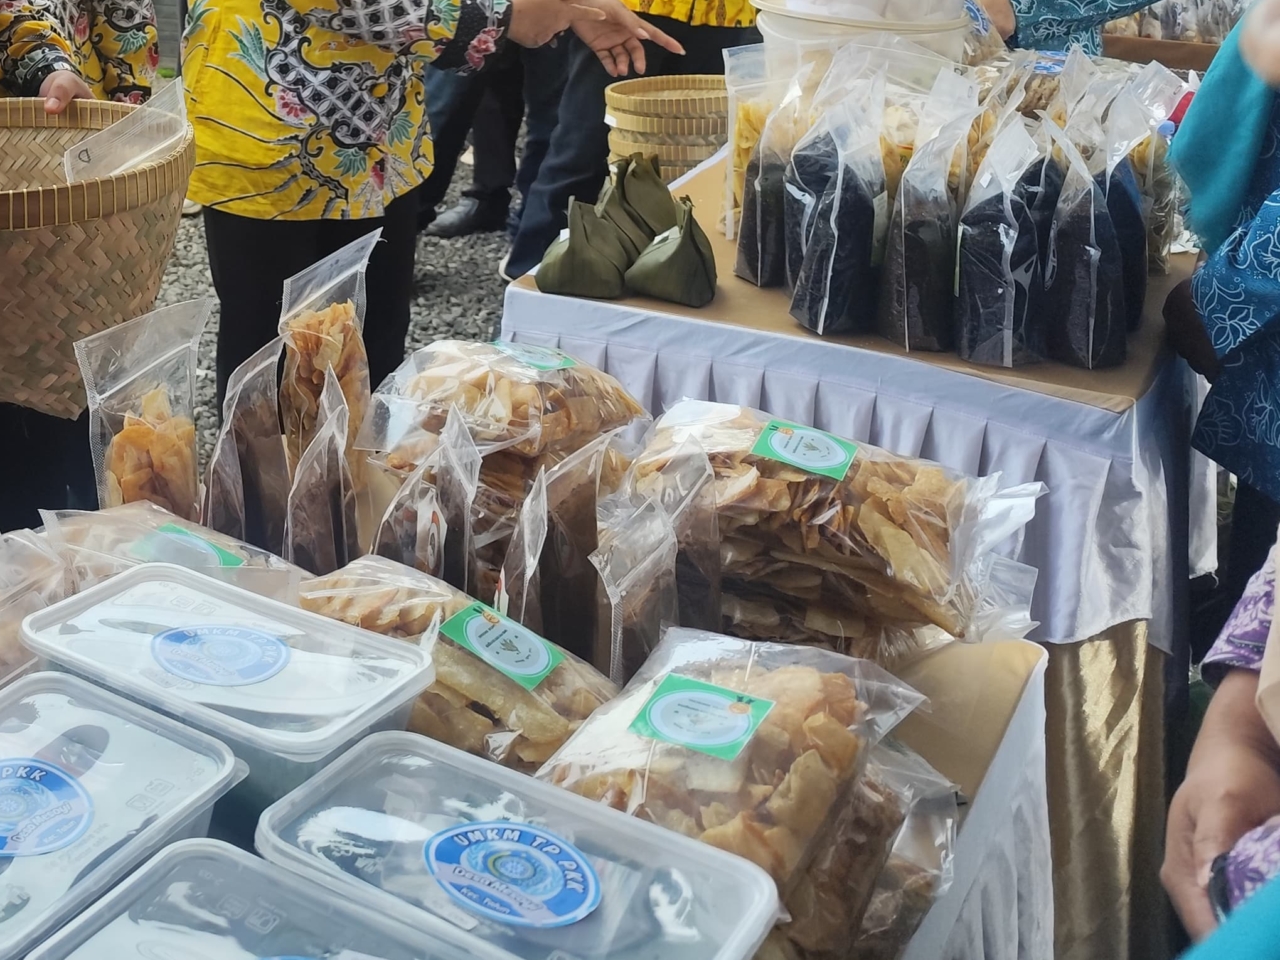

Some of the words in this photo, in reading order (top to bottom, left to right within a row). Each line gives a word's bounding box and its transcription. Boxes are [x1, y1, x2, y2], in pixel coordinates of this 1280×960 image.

[1, 766, 47, 782] PKK
[454, 828, 520, 846] UMKM
[531, 836, 561, 855] TP
[558, 860, 585, 894] PKK
[454, 866, 491, 886] Desa
